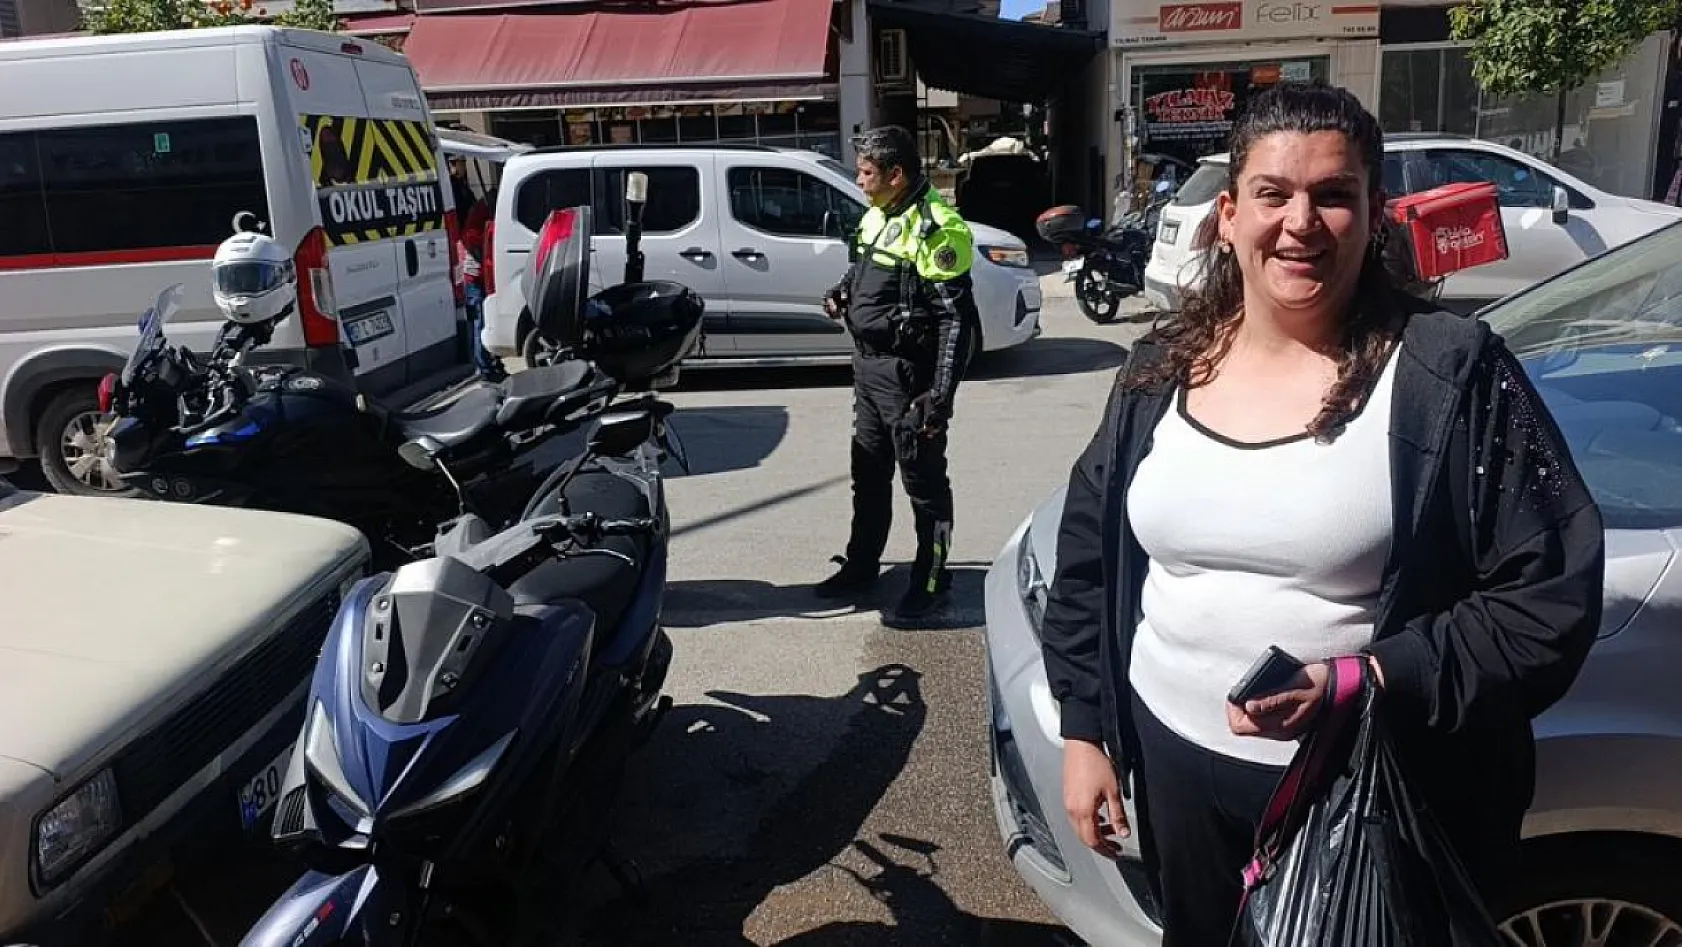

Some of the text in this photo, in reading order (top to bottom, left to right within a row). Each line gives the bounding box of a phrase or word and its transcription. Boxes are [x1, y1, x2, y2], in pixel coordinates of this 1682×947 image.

[329, 184, 436, 223] OKUL TAŞITI
[255, 766, 279, 810] 80
